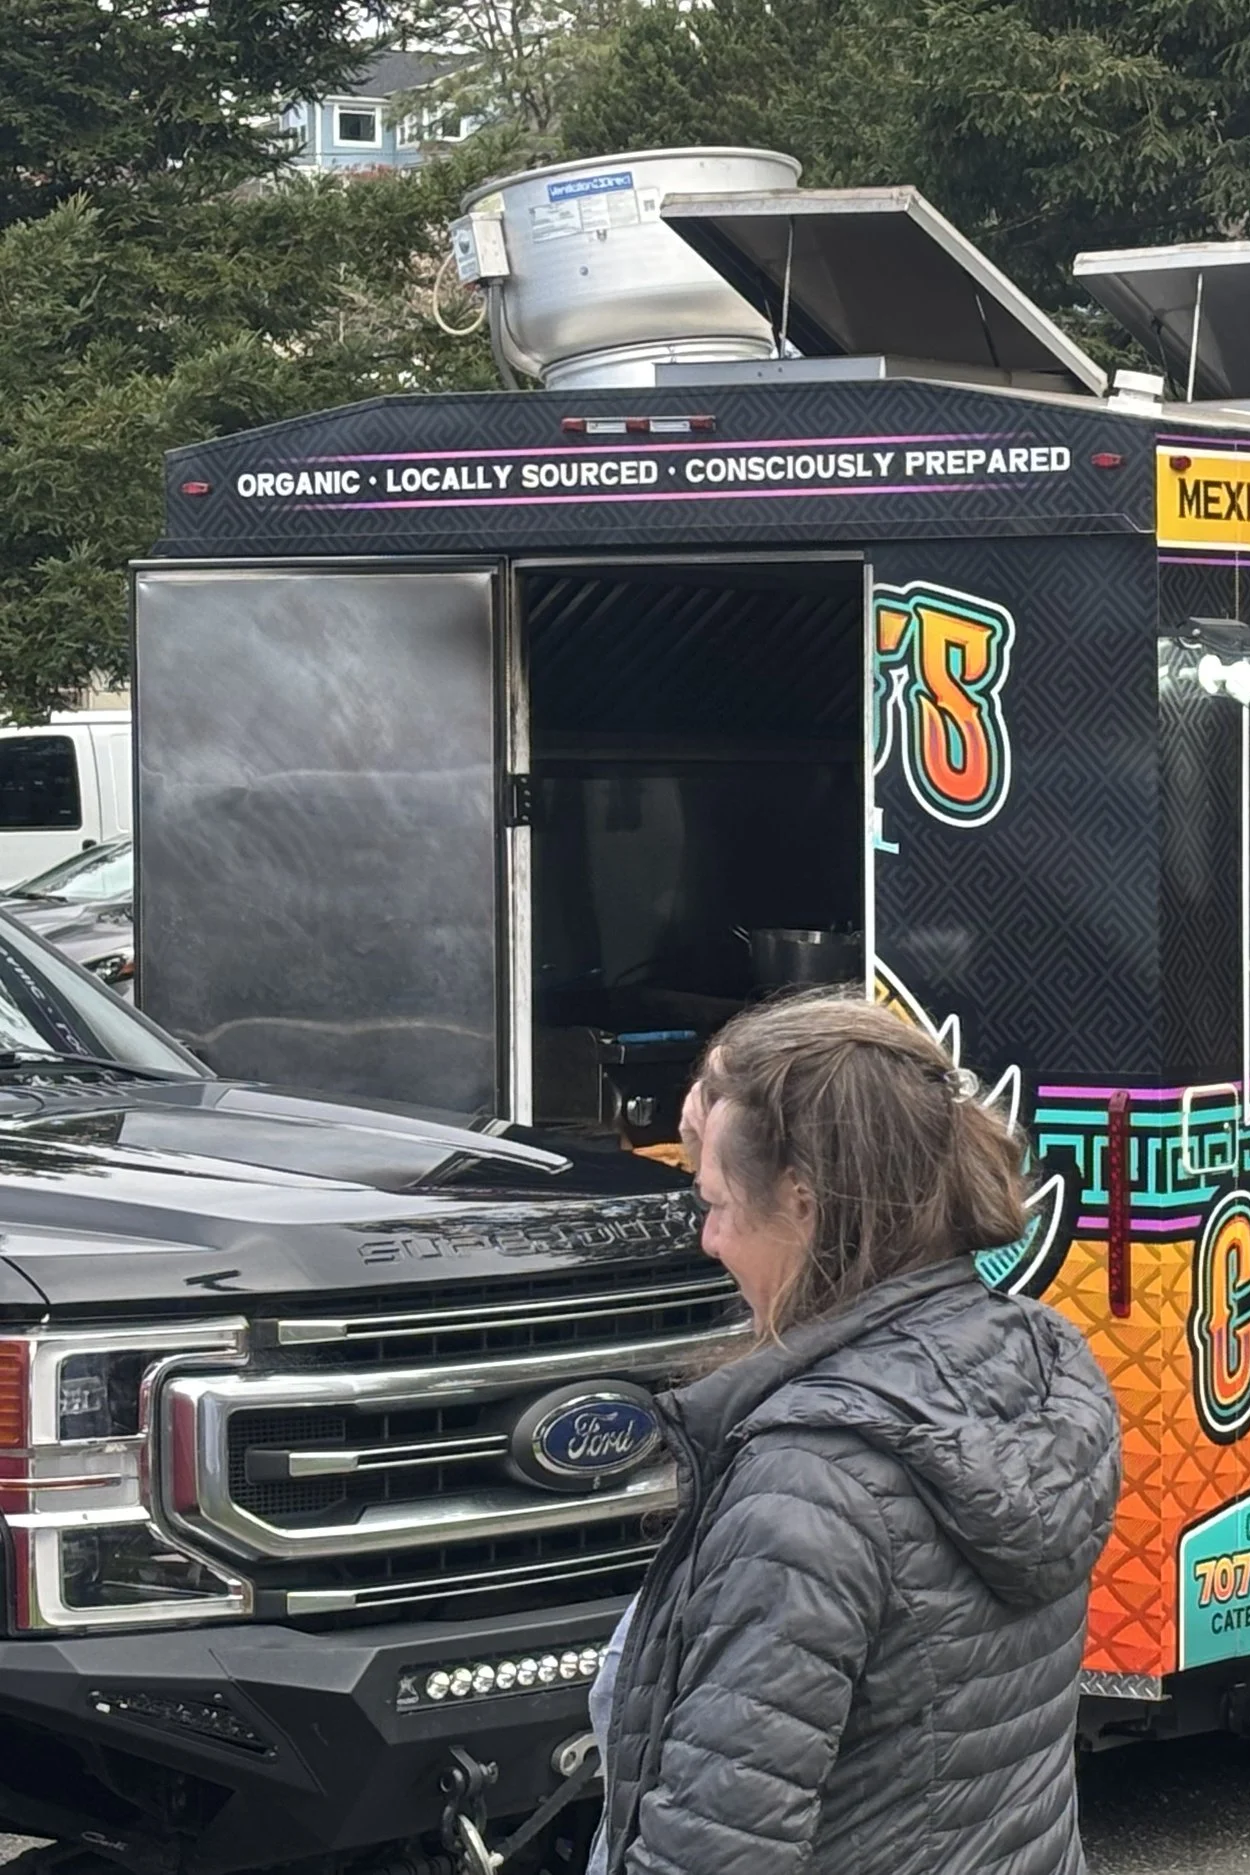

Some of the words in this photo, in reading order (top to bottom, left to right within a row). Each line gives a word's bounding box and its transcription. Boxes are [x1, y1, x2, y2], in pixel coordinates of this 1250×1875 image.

[237, 469, 361, 498] ORGANIC
[386, 464, 513, 493] LOCALLY
[521, 459, 659, 489] SOURCED
[685, 452, 896, 482] CONSCIOUSLY
[905, 446, 1071, 476] PREPARED
[568, 1411, 635, 1460] Ford
